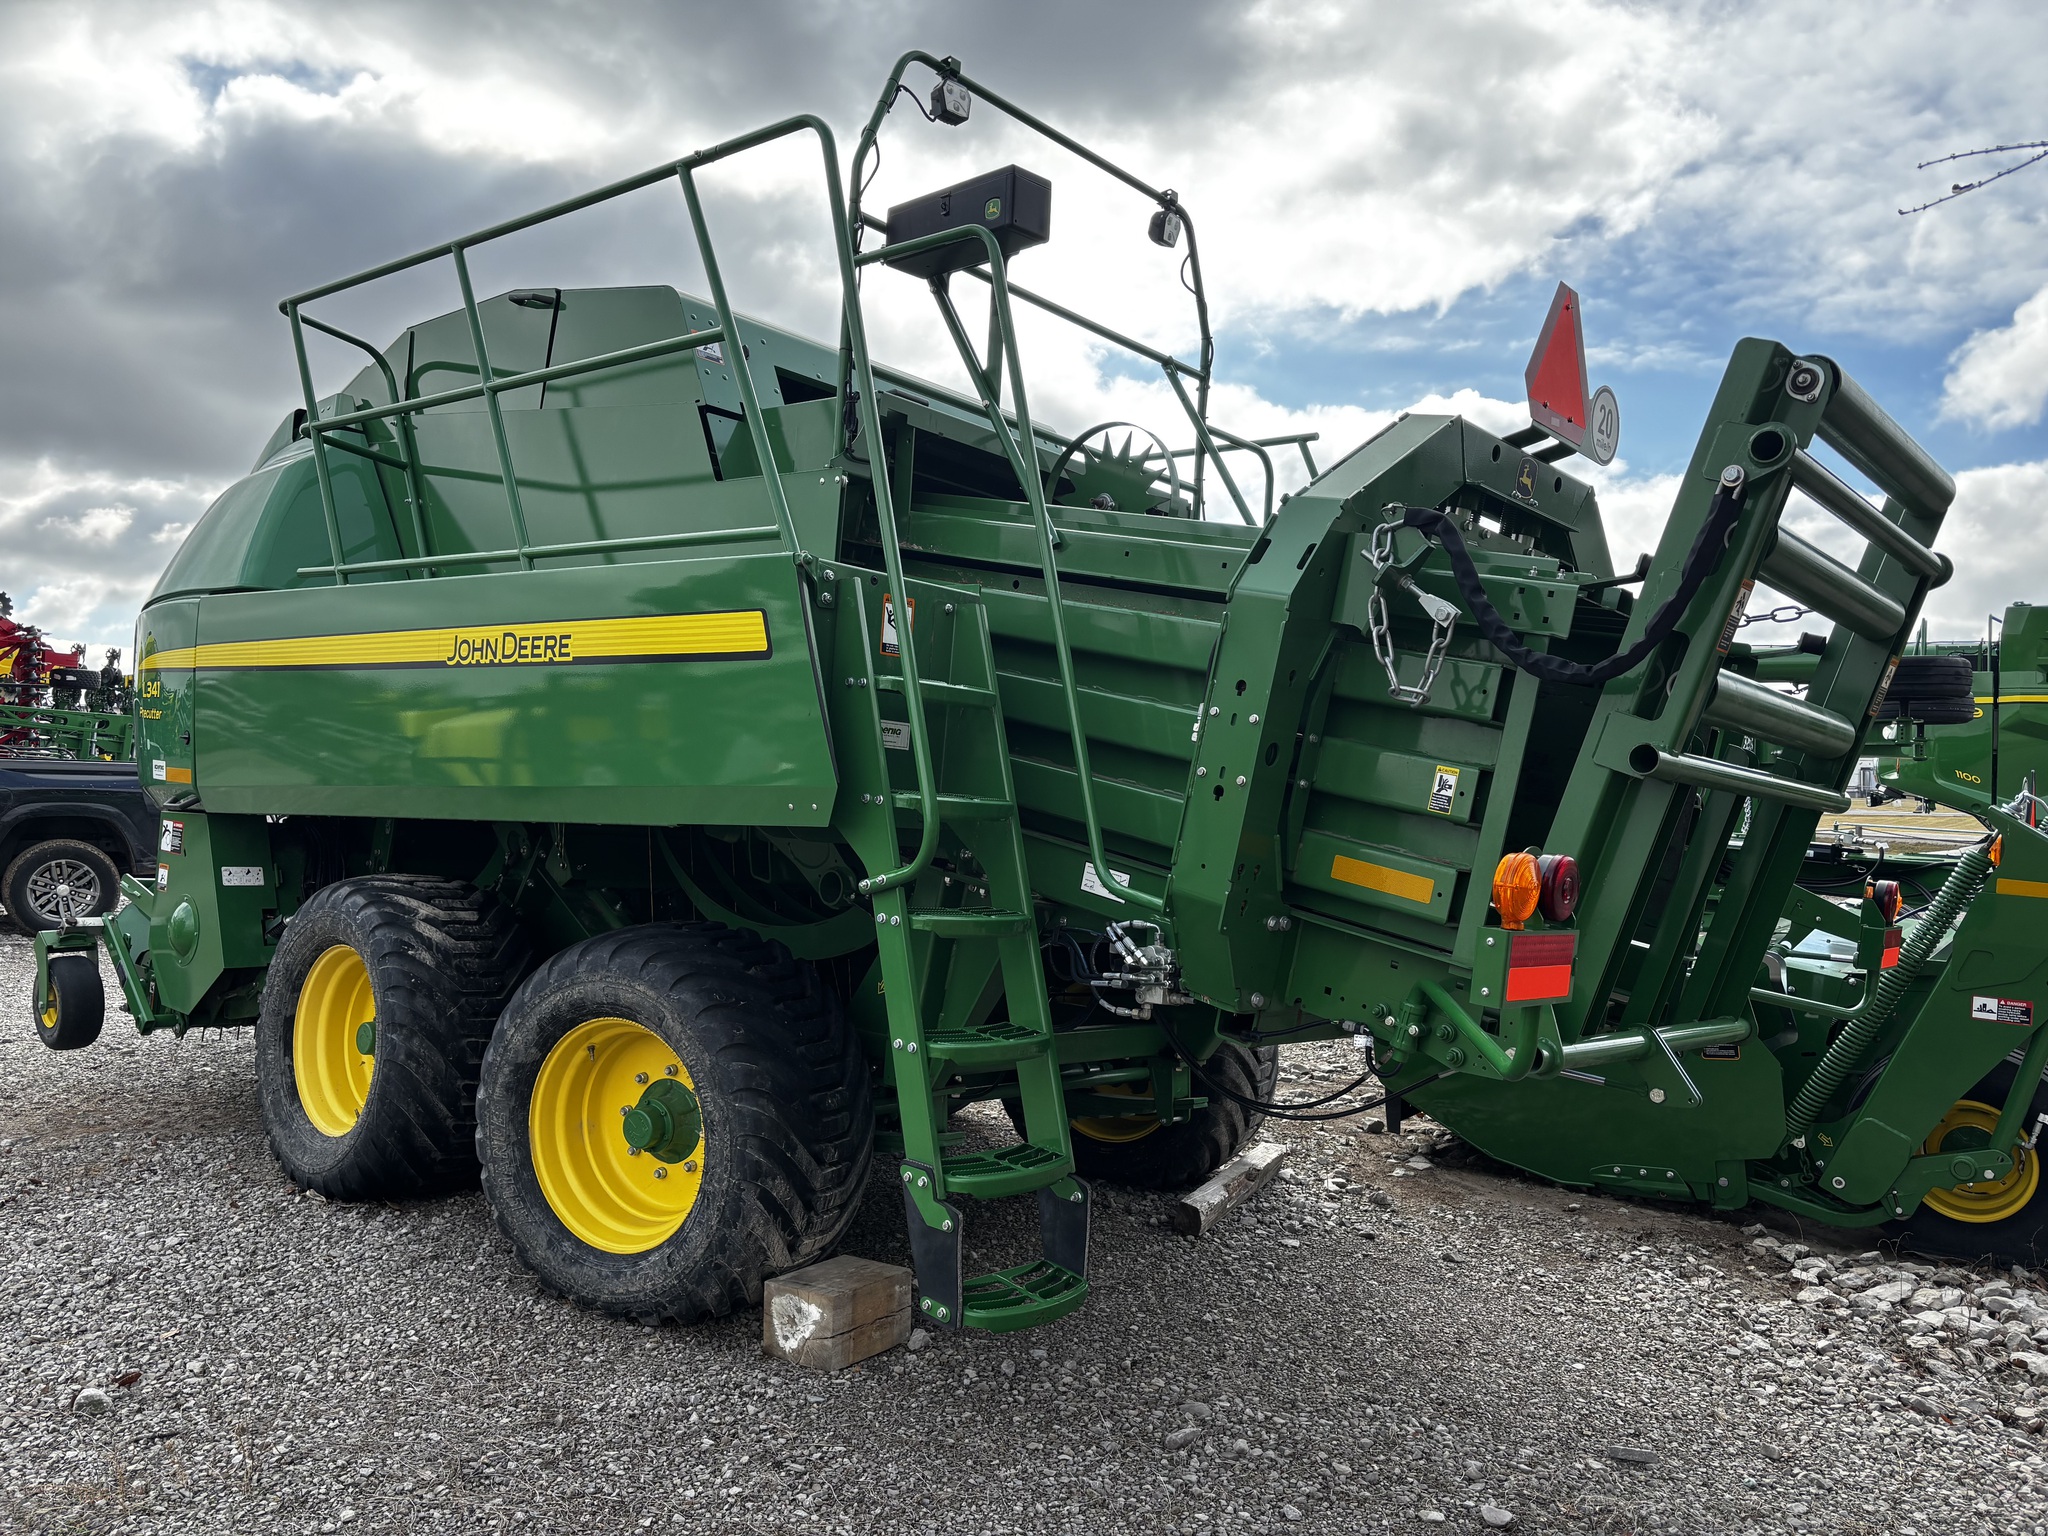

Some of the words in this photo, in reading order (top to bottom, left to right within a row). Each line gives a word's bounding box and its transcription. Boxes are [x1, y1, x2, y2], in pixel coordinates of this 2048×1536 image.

[1598, 404, 1612, 439] 20
[446, 634, 499, 662] JOHN
[501, 631, 572, 660] DEERE
[1955, 770, 1981, 783] 1100
